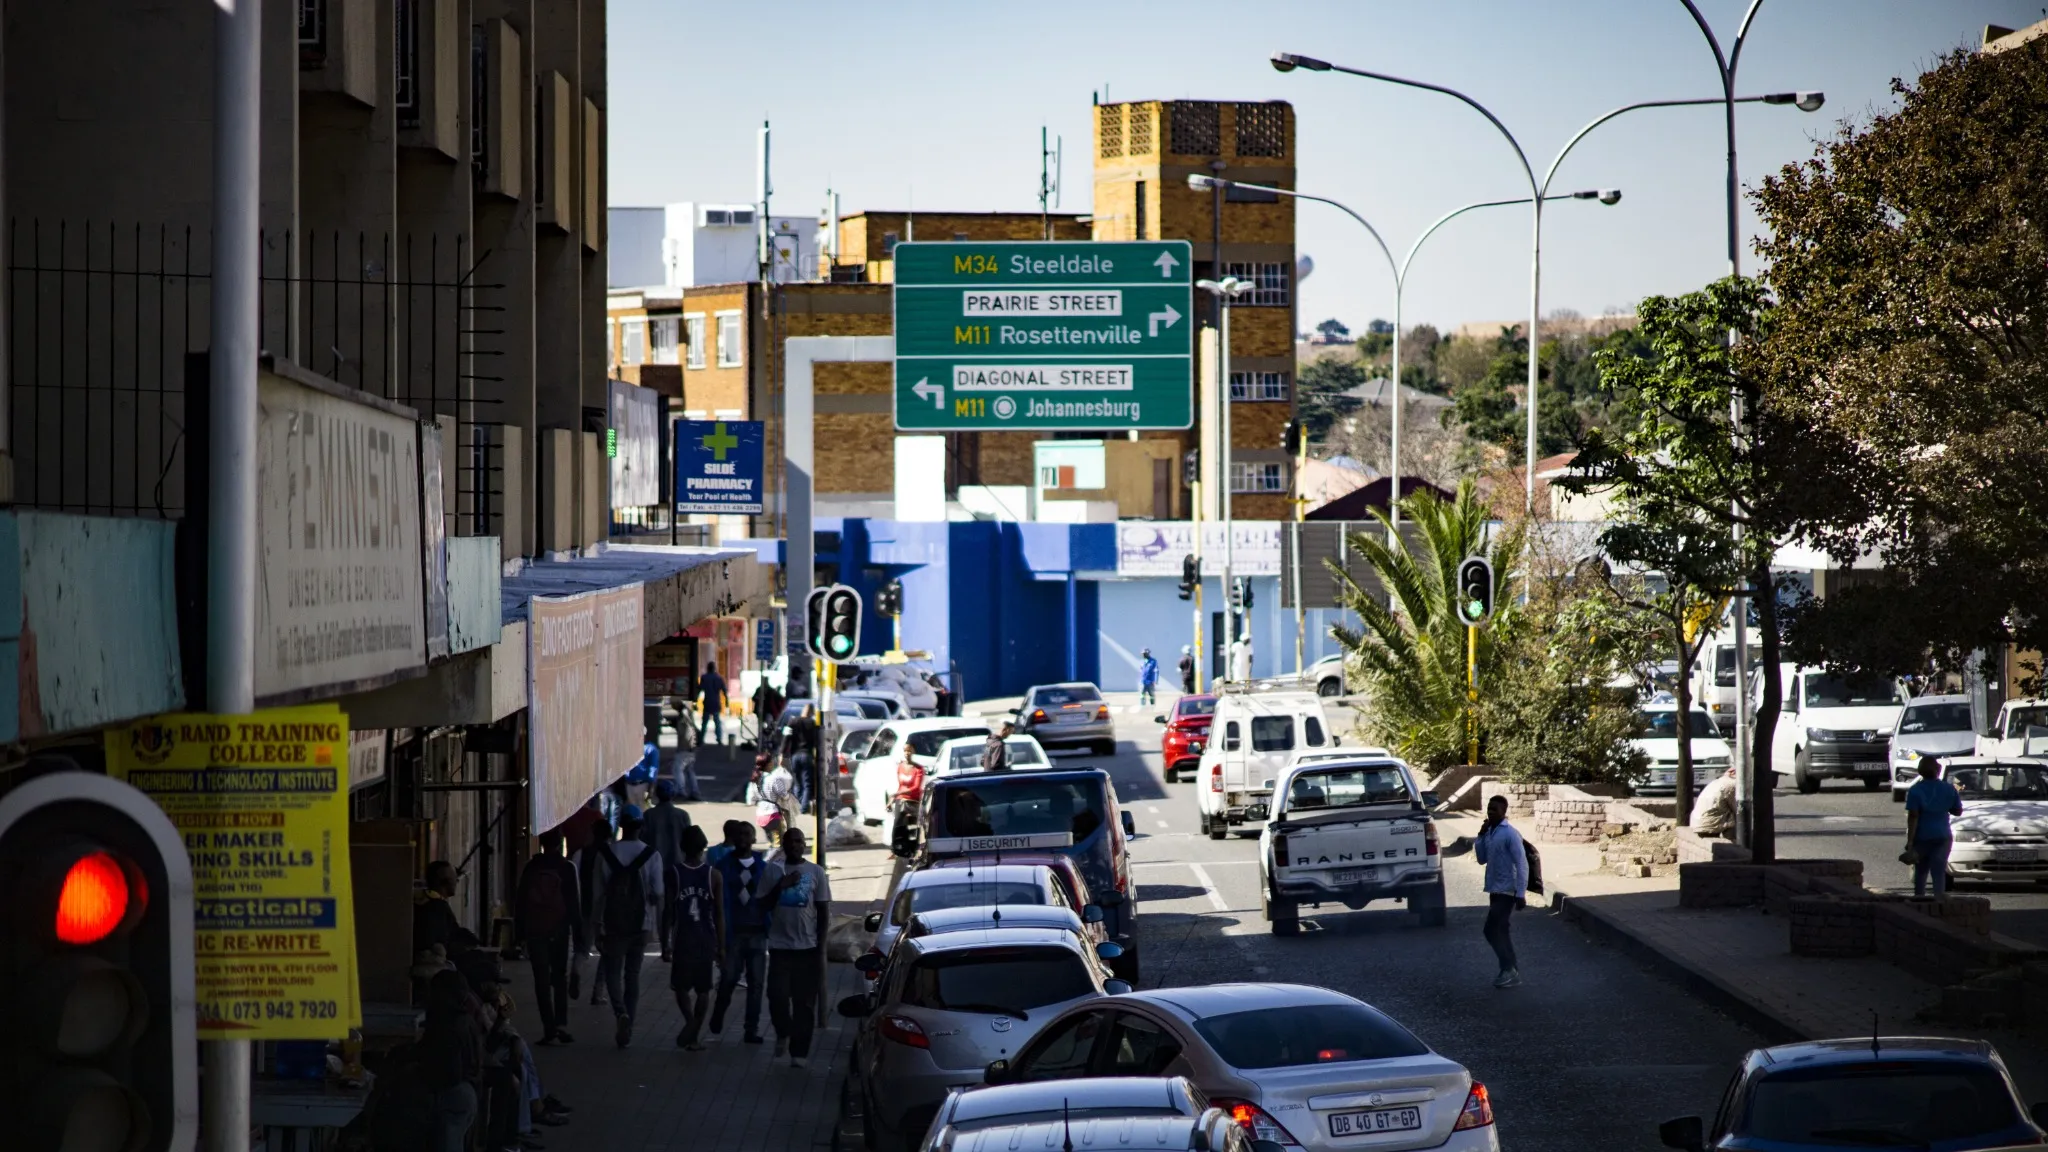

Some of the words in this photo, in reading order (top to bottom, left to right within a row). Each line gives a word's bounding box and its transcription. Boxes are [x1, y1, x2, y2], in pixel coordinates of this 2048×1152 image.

[955, 255, 998, 274] M34
[1010, 254, 1114, 274] Steeldale
[967, 296, 1039, 310] PRAIRIE
[1049, 295, 1118, 310] STREET
[955, 326, 990, 344] M11
[1000, 325, 1142, 344] Rosettenville
[957, 371, 1049, 386] DIAGONAL
[1060, 370, 1129, 385] STREET
[955, 398, 985, 417] M11
[1025, 398, 1140, 421] Johannesburg
[286, 411, 402, 551] FEMINISTA
[686, 477, 753, 490] PHARMACY
[688, 492, 703, 500] Your
[729, 493, 753, 501] Health
[762, 622, 770, 633] P
[180, 723, 231, 742] RAND
[237, 723, 340, 743] TRAINING
[209, 744, 307, 763] COLLEGE
[131, 772, 194, 790] ENGINEERING
[206, 771, 276, 790] TECHNOLOGY
[278, 771, 334, 789] INSTITUTE
[238, 812, 273, 827] NOW
[185, 832, 208, 847] ER
[213, 832, 284, 848] MAKER
[972, 837, 1026, 850] SECURITY
[239, 850, 313, 866] SKILLS
[1297, 848, 1418, 866] RANGER
[688, 897, 701, 922] 4
[195, 934, 216, 950] IC
[223, 934, 321, 950] RE-WRITE
[305, 963, 338, 973] FLOOR
[267, 976, 314, 986] BUILDING
[233, 1002, 261, 1019] 073
[266, 1001, 295, 1019] 942
[299, 1001, 337, 1019] 7920
[1334, 1116, 1351, 1133] DB
[1356, 1114, 1372, 1131] 40
[1375, 1112, 1390, 1128] GT
[1400, 1110, 1416, 1127] GP
